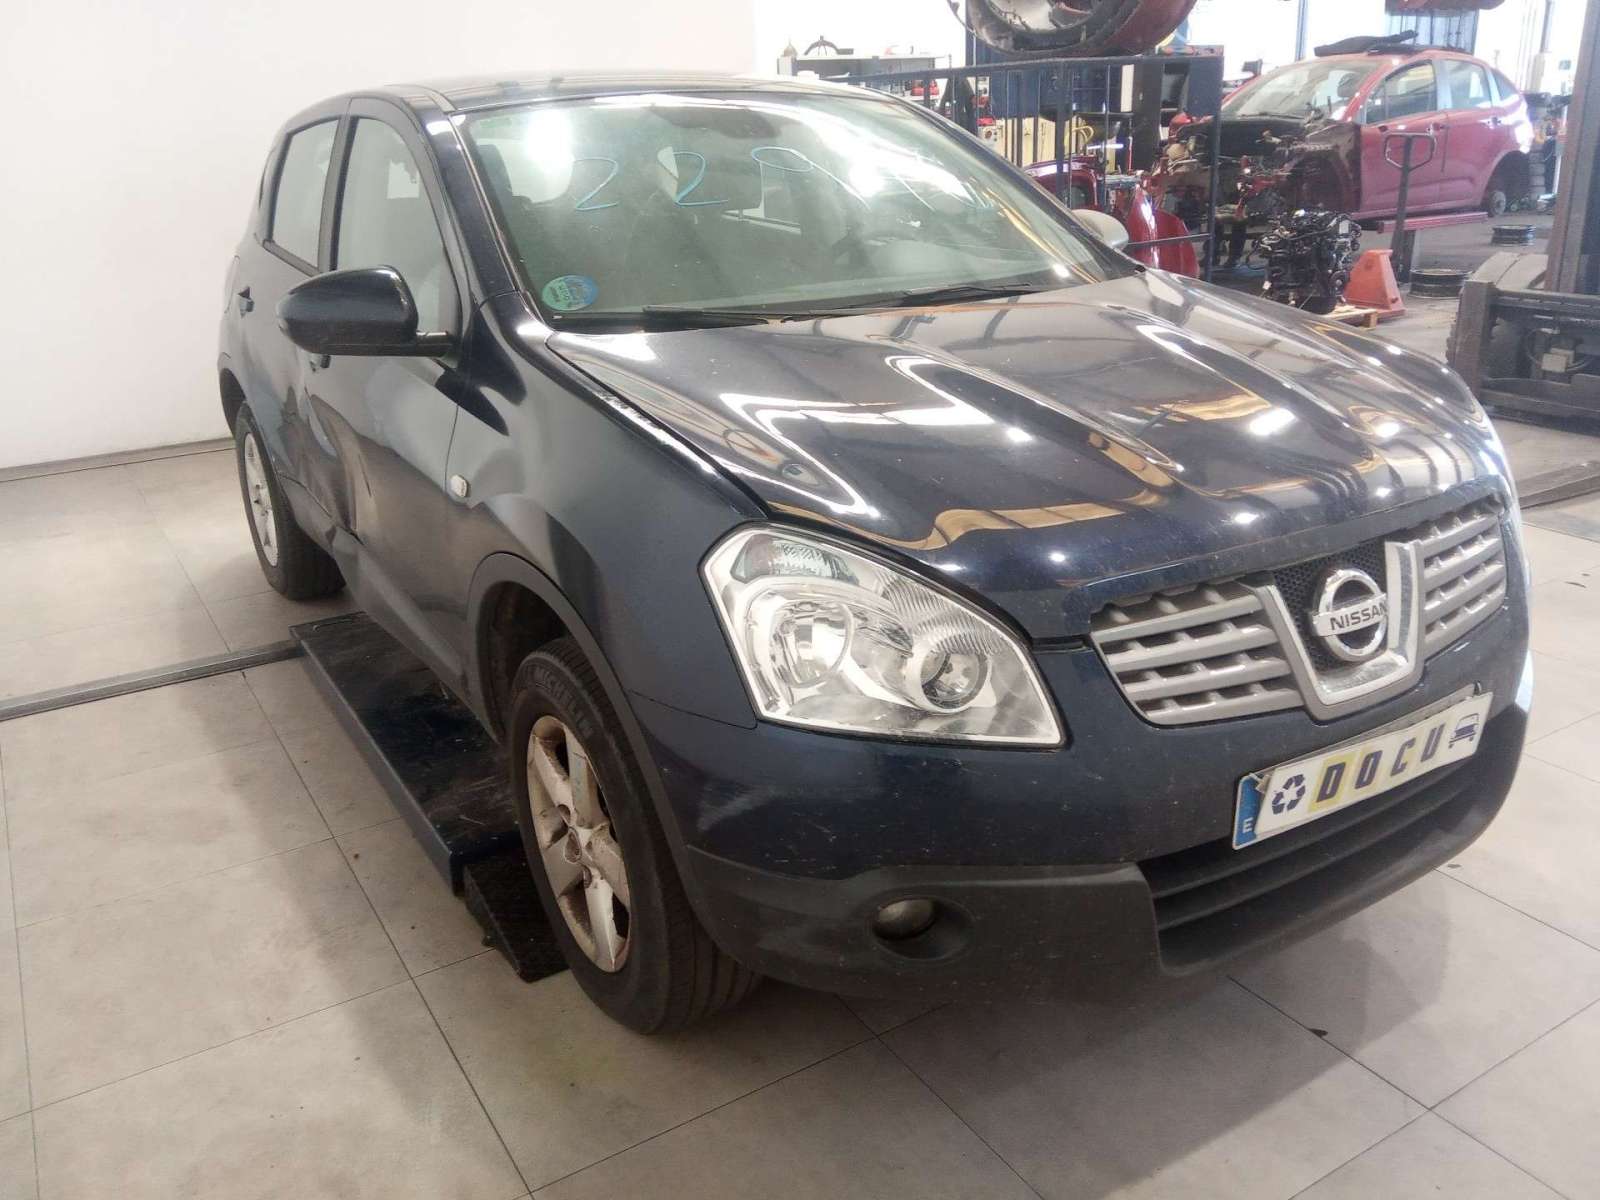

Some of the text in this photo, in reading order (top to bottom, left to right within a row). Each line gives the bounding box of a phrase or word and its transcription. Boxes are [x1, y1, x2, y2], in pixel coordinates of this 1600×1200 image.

[1330, 602, 1387, 631] NISSAN
[1315, 723, 1446, 803] DOCU
[1242, 816, 1254, 834] E
